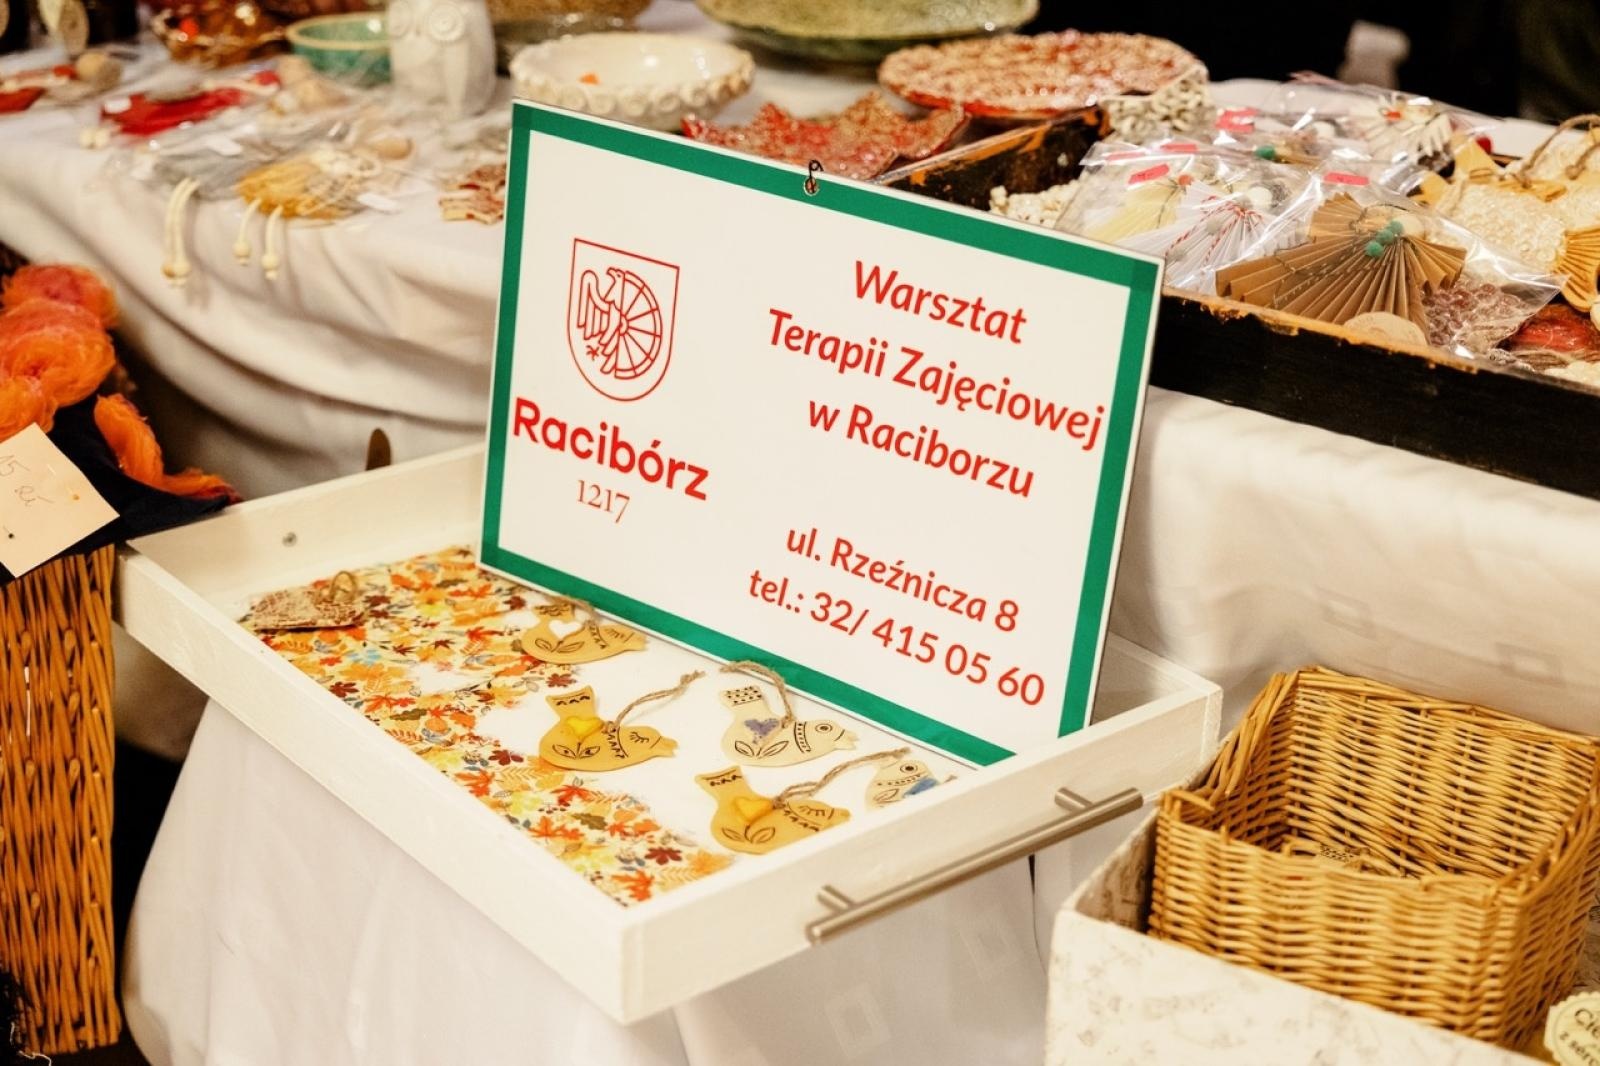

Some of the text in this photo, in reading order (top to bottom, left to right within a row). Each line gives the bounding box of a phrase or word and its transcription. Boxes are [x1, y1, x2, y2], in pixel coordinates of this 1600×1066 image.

[855, 259, 1028, 345] Warsztat
[768, 307, 1106, 452] Terapii Zajęciowej
[512, 396, 710, 501] Racibórz
[808, 400, 1035, 498] w Raciborzu
[575, 479, 631, 524] 1217
[786, 527, 1020, 633] ul. Rzeźnicza 8
[748, 570, 1046, 707] tel.: 32/ 415 05 60
